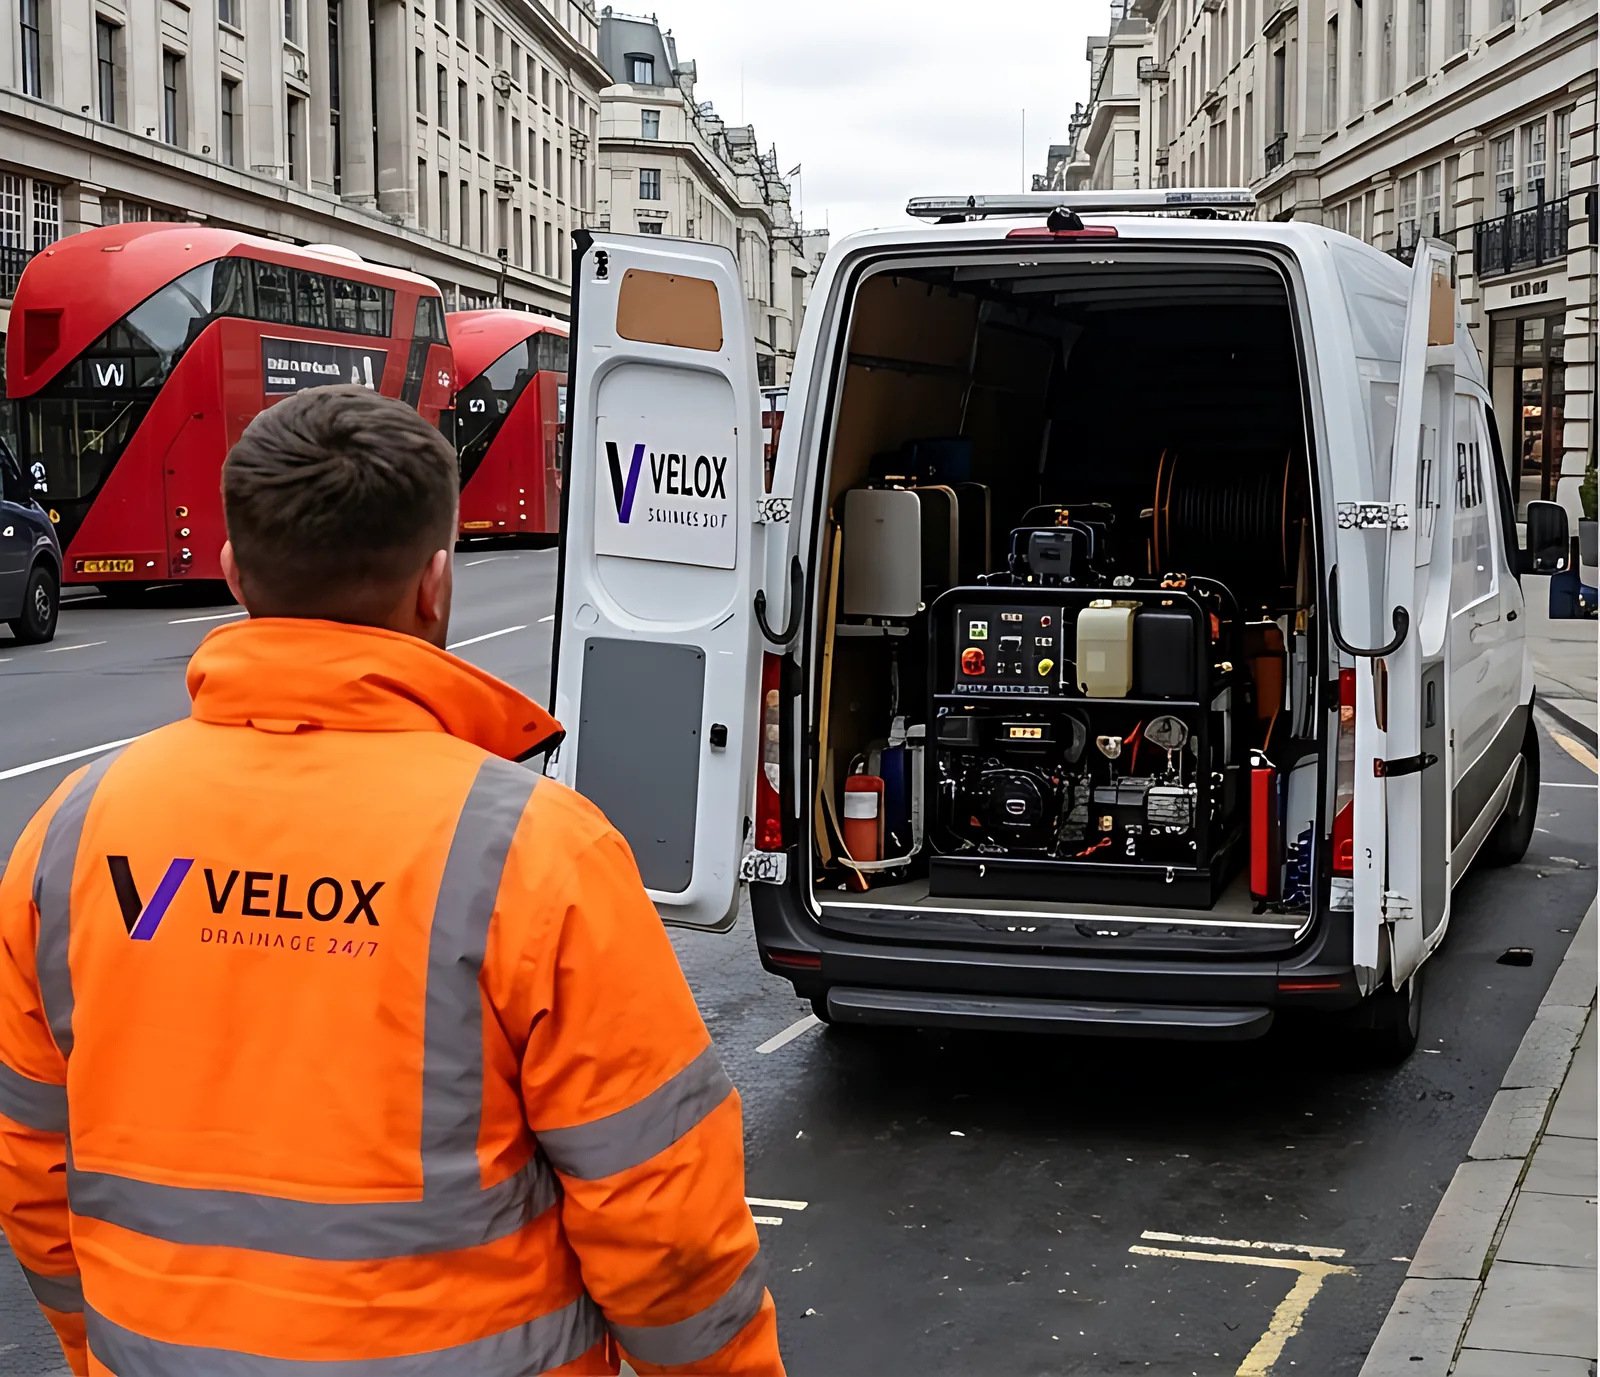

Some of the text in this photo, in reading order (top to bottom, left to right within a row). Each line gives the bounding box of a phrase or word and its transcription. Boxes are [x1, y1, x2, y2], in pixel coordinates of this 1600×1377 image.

[649, 452, 728, 500] VELOX
[203, 868, 386, 926] VELOX
[200, 927, 379, 958] DRAINAGE 24/7
